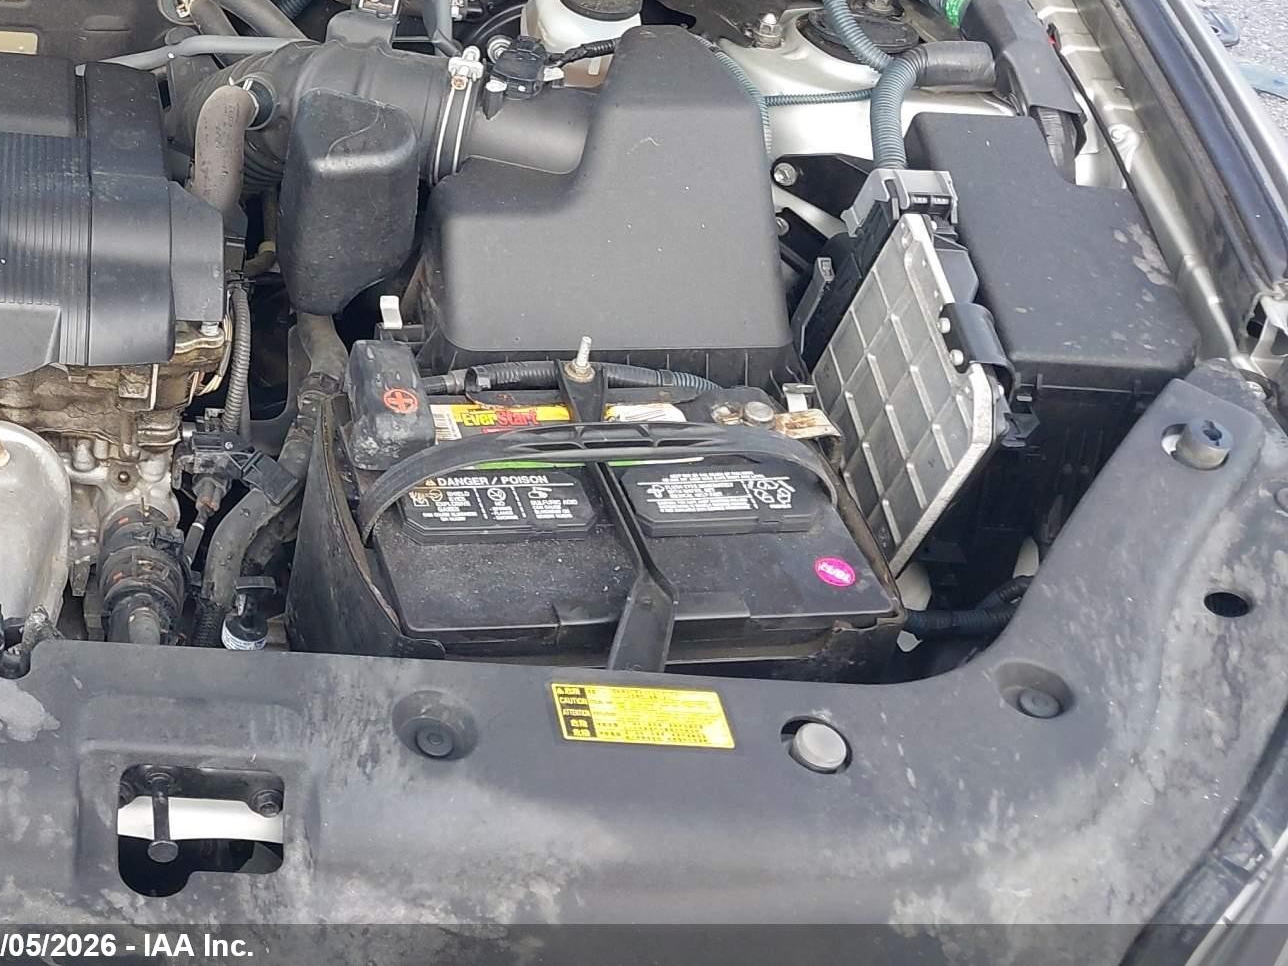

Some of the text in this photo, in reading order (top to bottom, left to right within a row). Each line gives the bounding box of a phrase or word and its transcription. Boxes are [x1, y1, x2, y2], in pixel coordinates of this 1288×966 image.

[463, 409, 540, 427] EverStart
[437, 475, 549, 486] DANGER / POISON
[559, 697, 588, 705] CAUTION
